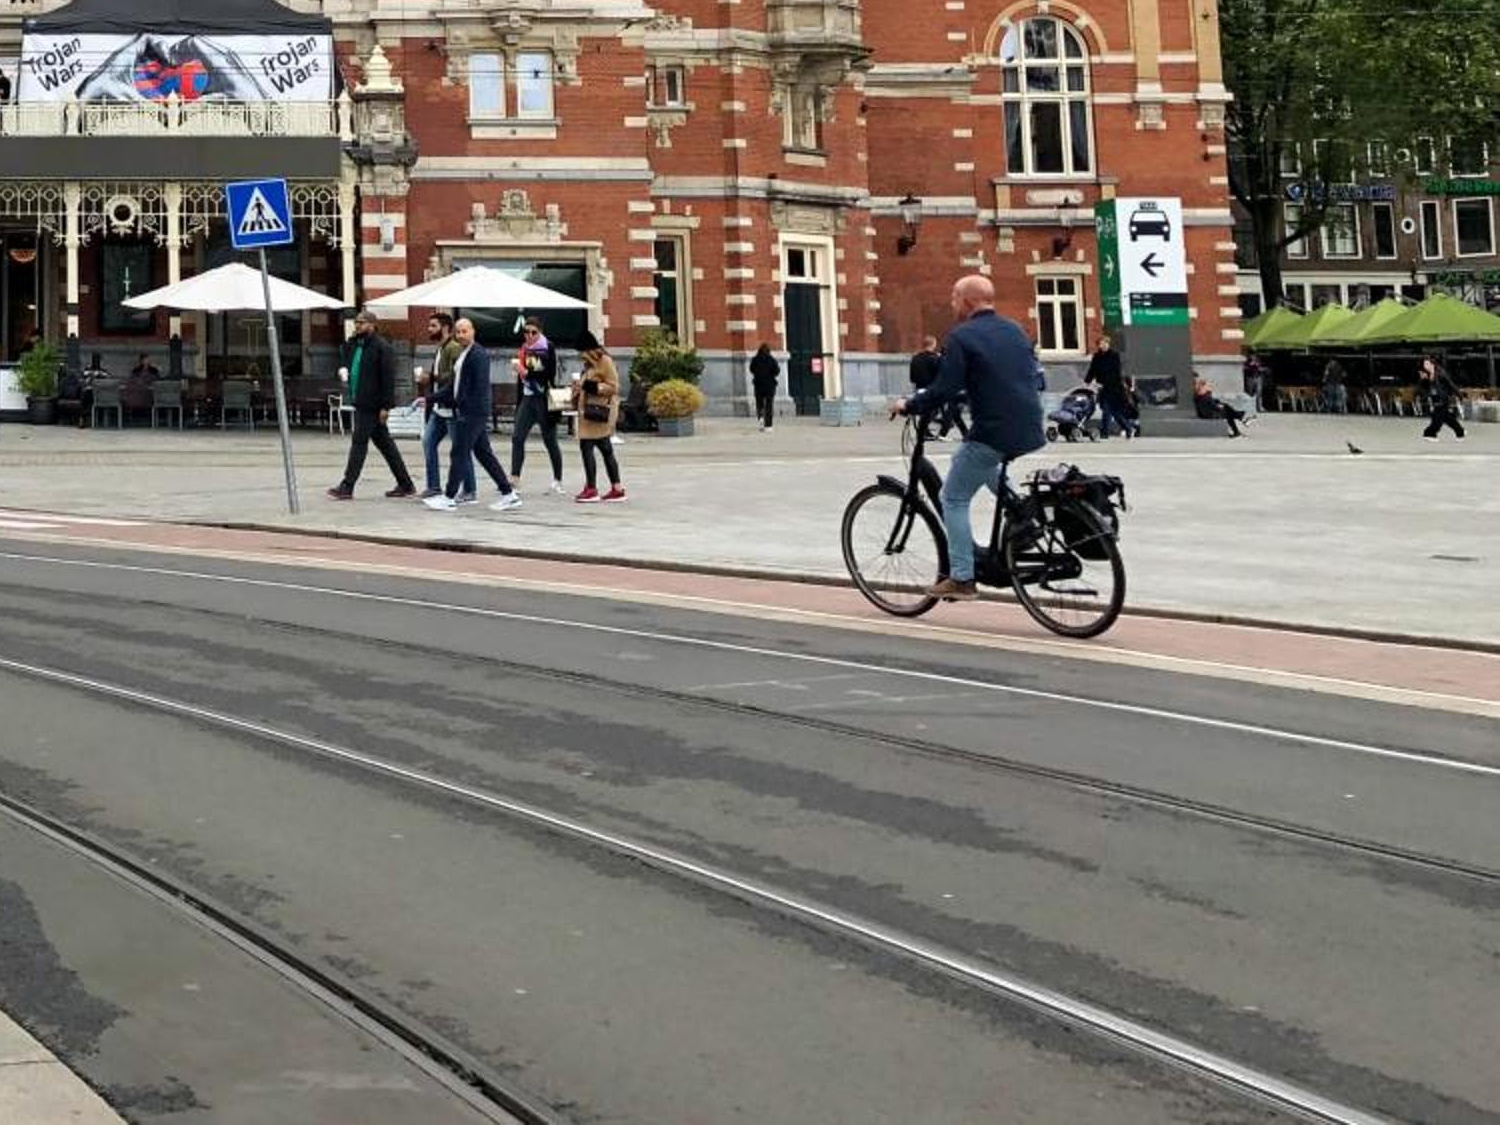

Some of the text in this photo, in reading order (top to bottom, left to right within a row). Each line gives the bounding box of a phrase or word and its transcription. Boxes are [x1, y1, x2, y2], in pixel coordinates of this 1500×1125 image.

[25, 37, 81, 75] Trojan
[37, 58, 83, 92] Wars
[270, 58, 319, 93] Wars
